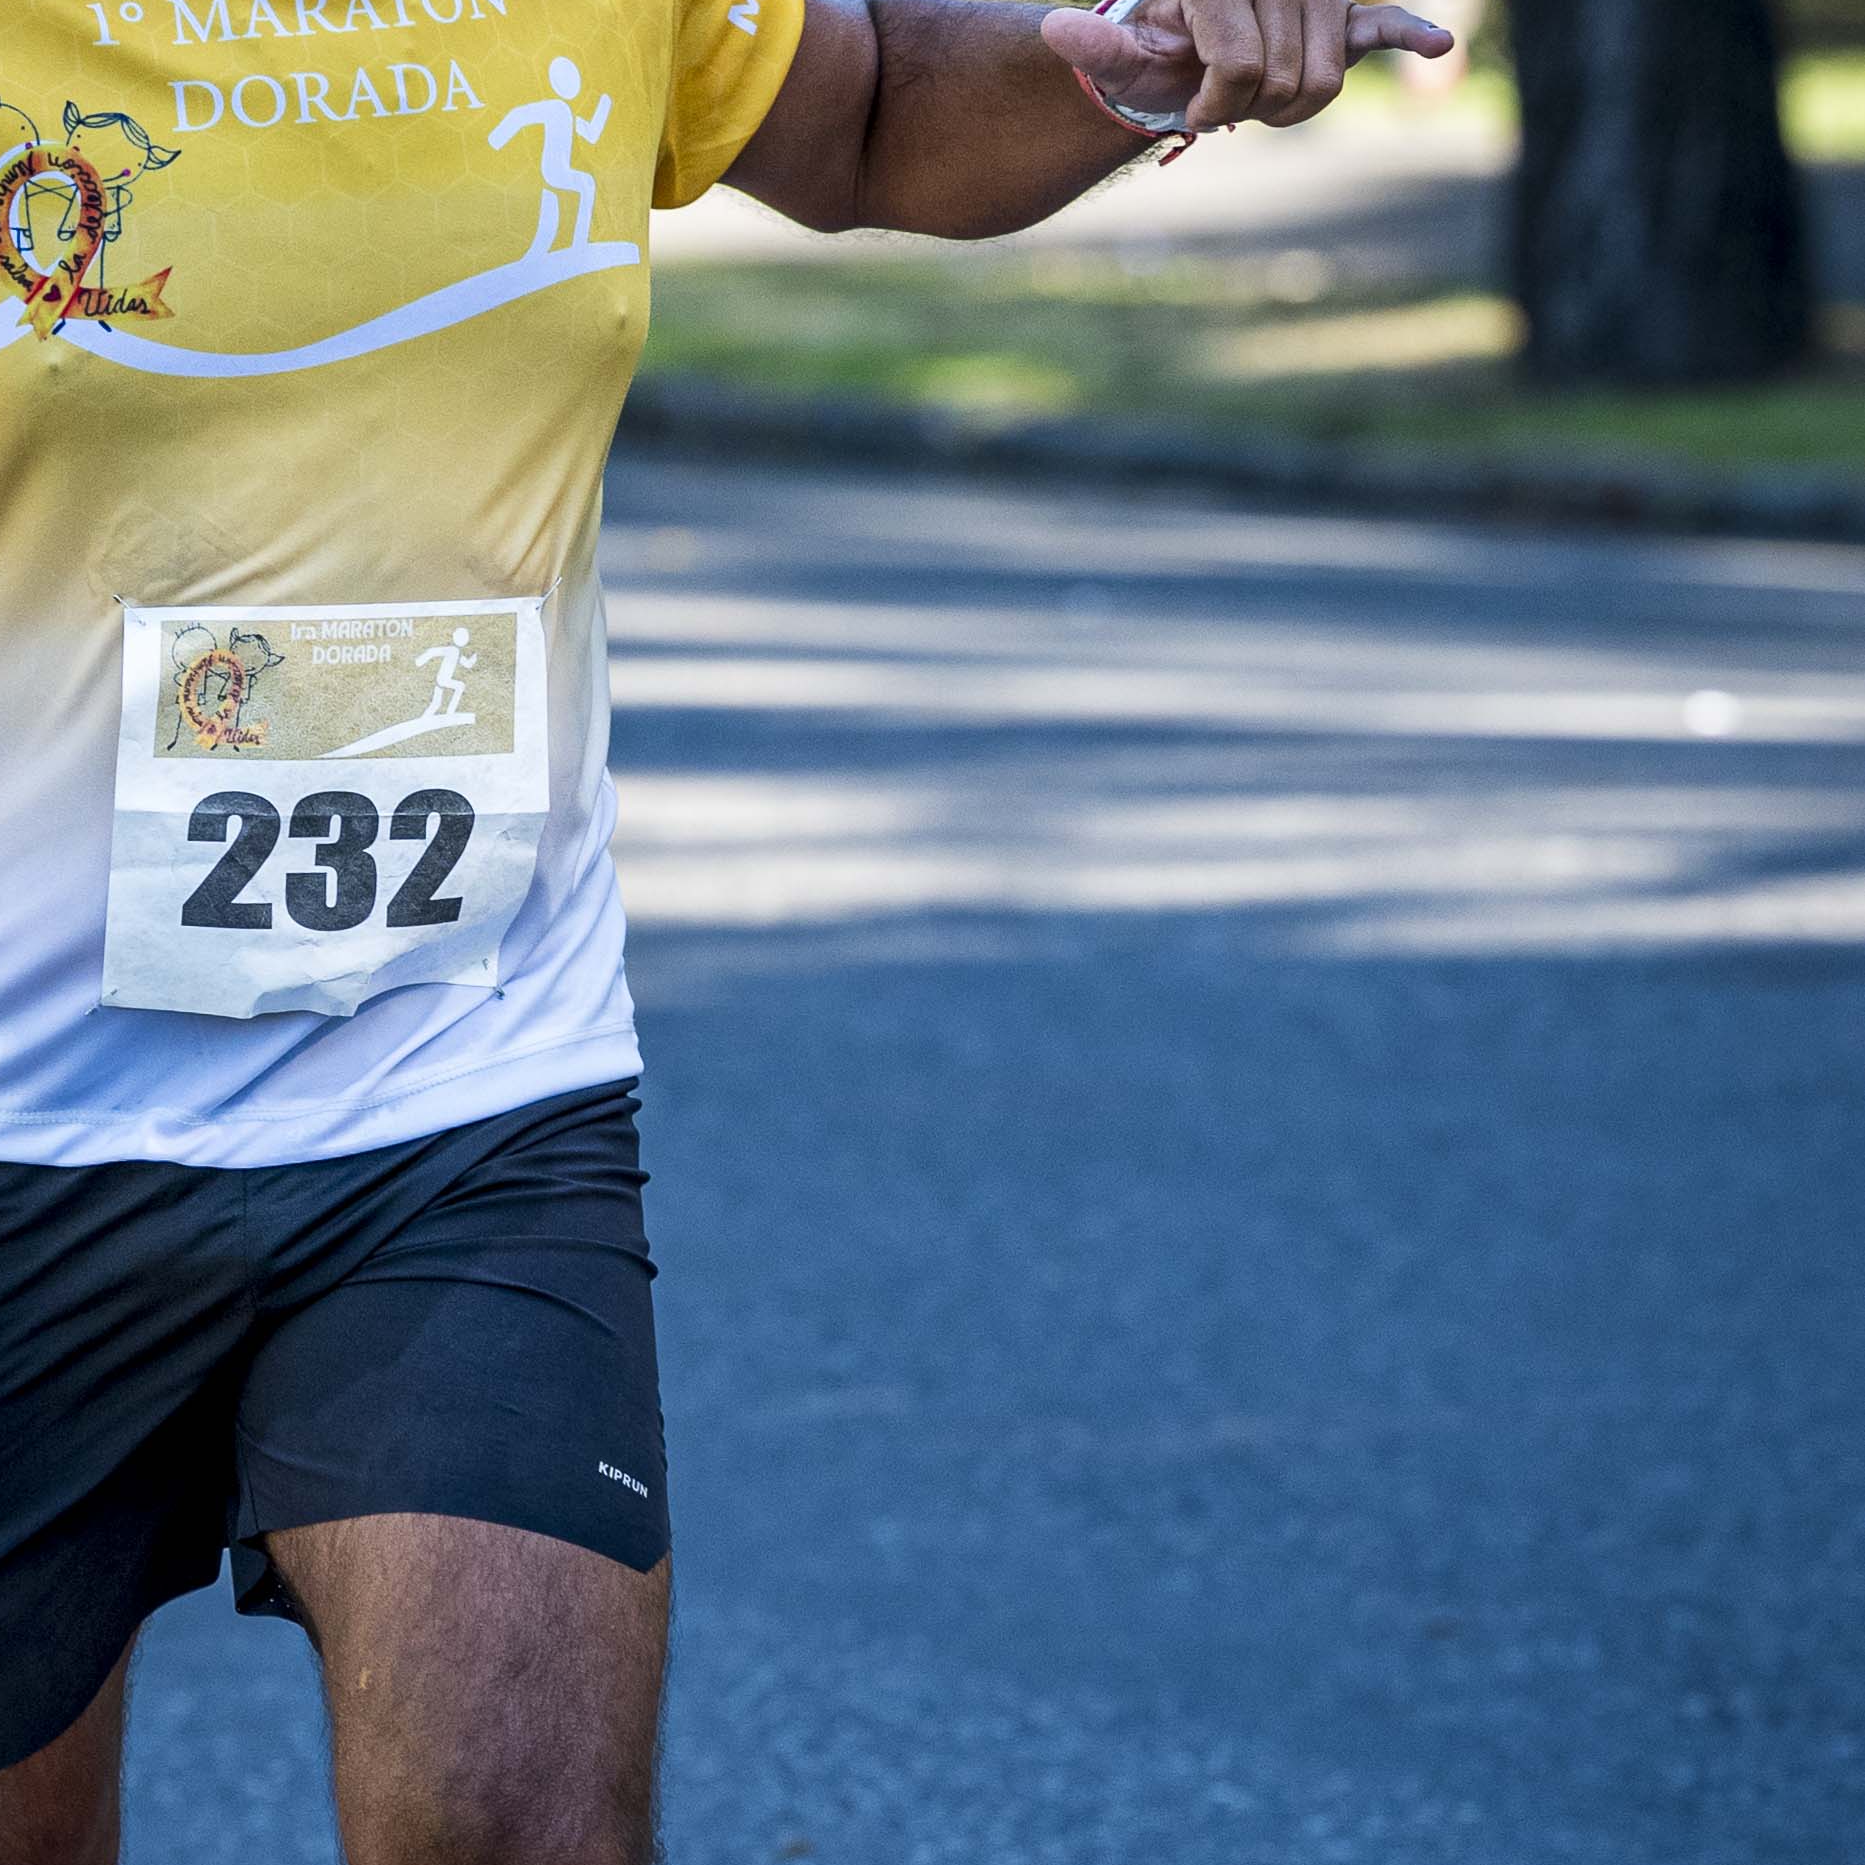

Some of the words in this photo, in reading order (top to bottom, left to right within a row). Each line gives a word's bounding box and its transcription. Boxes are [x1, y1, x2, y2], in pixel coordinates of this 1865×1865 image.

[167, 59, 486, 133] DORADA
[312, 644, 391, 664] DORADA
[181, 788, 475, 931] 232
[598, 1461, 648, 1498] KIPRUN
